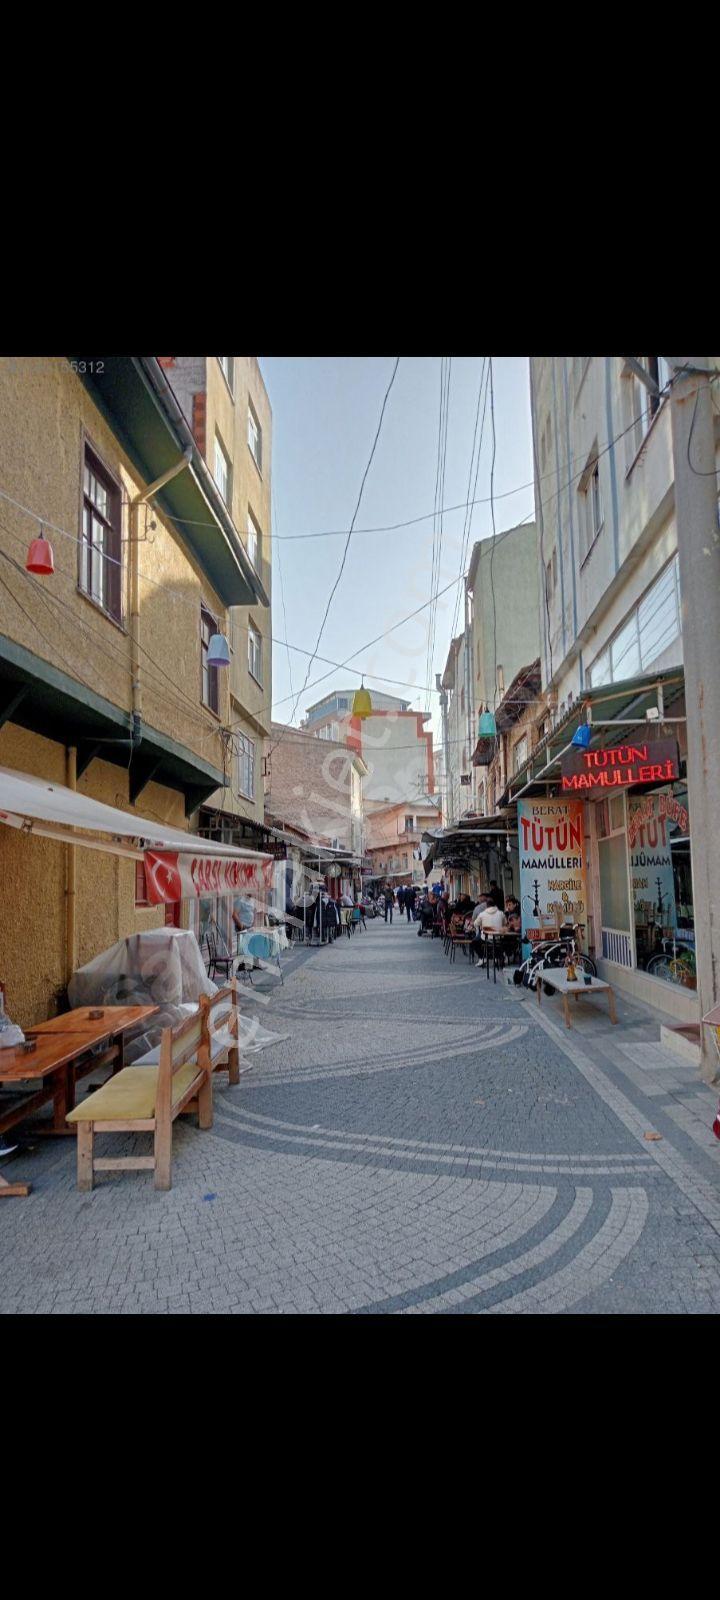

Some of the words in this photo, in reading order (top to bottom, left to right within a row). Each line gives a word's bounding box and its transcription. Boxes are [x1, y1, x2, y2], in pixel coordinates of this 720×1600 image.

[584, 746, 648, 769] TÜTÜN
[532, 806, 570, 815] BERAT
[521, 816, 583, 853] TÜTÜN
[521, 854, 583, 870] MAMÜLLERİ
